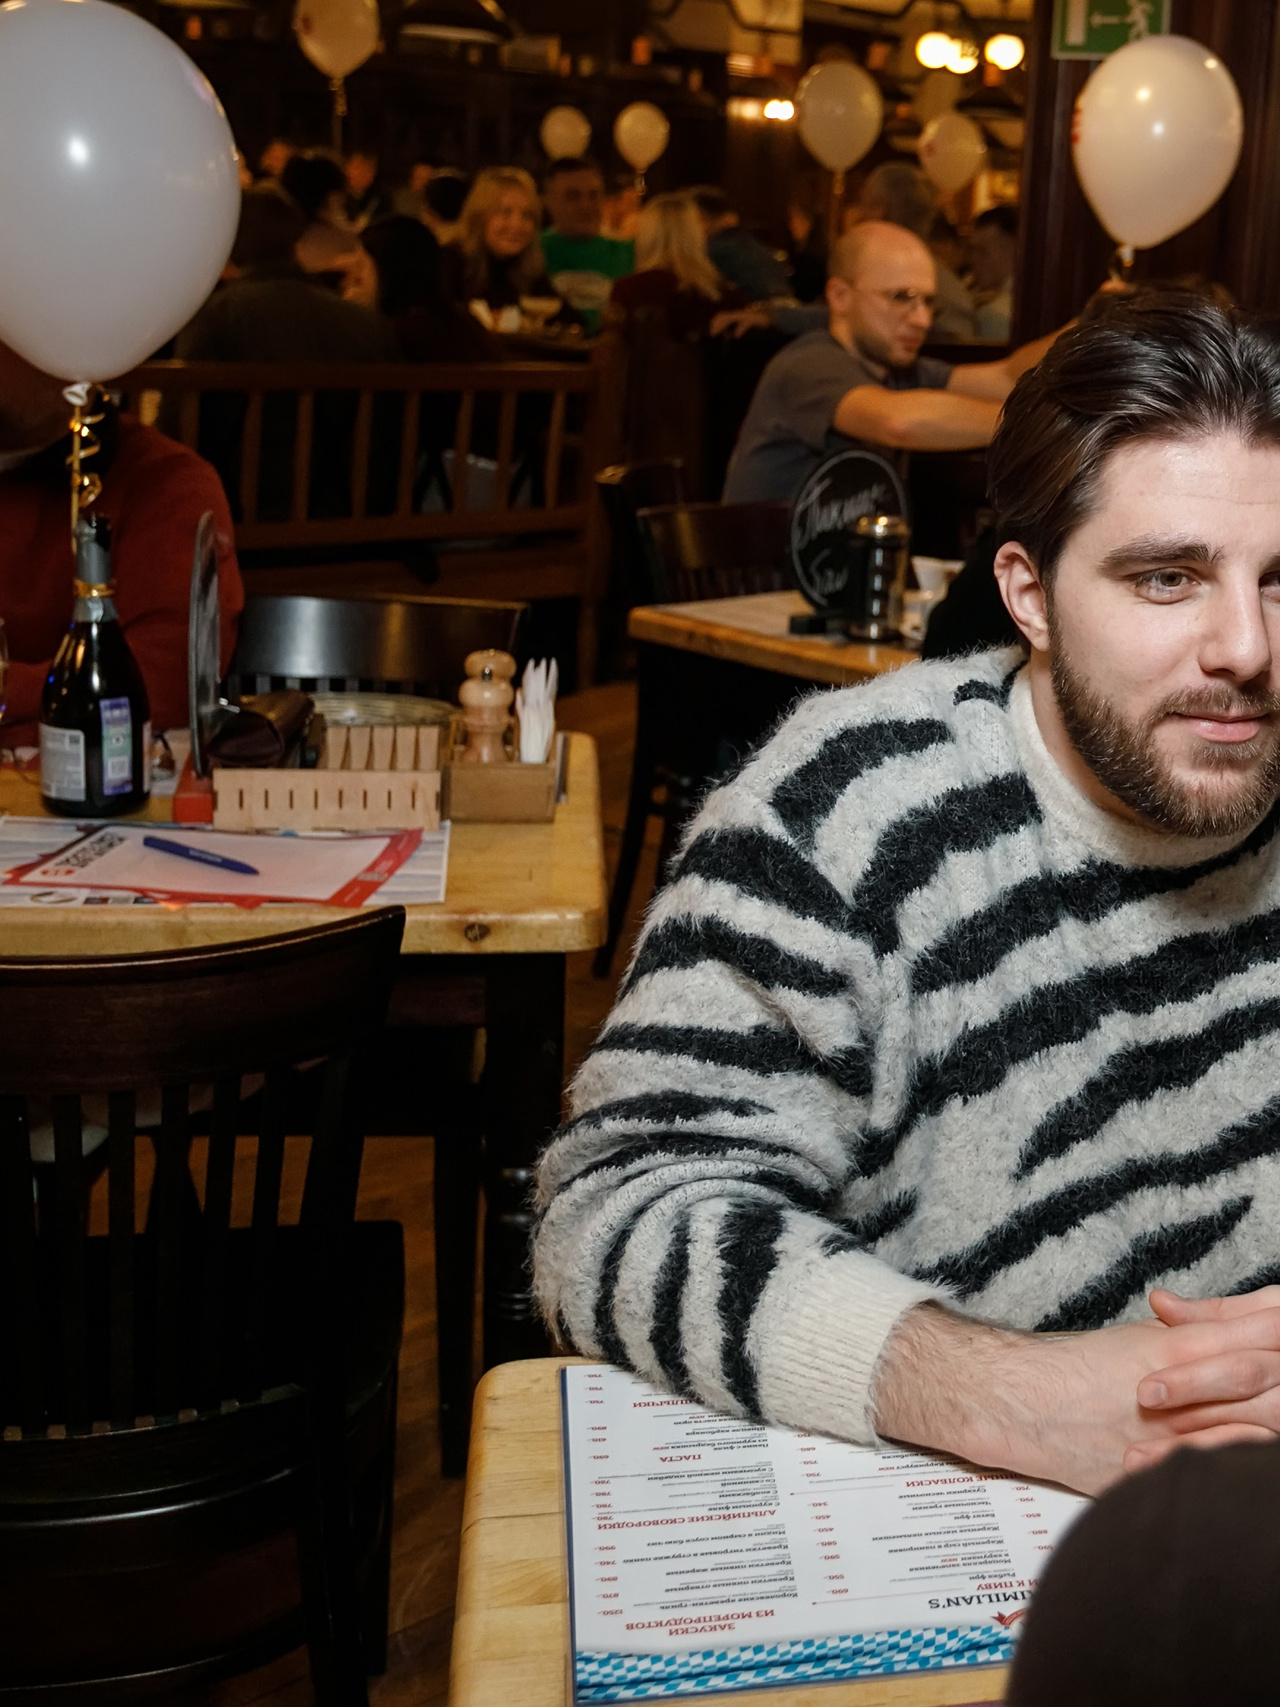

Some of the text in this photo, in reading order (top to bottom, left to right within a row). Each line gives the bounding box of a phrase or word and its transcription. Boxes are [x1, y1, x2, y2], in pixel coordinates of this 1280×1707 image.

[633, 1398, 692, 1408] ШЛЫЧКИ
[670, 1442, 716, 1450] бедрышка
[717, 1438, 756, 1446] куриного
[659, 1454, 701, 1462] ПАСТА
[882, 1452, 919, 1460] колбаска
[896, 1462, 944, 1470] Карривурст
[722, 1467, 766, 1475] кусочками
[906, 1476, 973, 1488] КОЛБАСКИ
[718, 1490, 770, 1498] колбасками
[898, 1492, 945, 1500] чесночные
[708, 1504, 730, 1512] филе
[732, 1501, 772, 1510] куриным
[944, 1500, 991, 1508] Чесночные
[598, 1509, 776, 1530] АЛЬПИЙСКИЕ СКОВОРОДКИ
[959, 1526, 999, 1534] Жареные
[710, 1534, 746, 1542] сырном
[872, 1532, 923, 1542] пельмешки
[962, 1538, 1004, 1548] Жареный
[700, 1548, 744, 1556] тигровые
[746, 1544, 788, 1552] Креветки
[888, 1546, 936, 1554] панировке
[653, 1553, 692, 1561] стружке
[962, 1558, 1011, 1568] Моцарелла
[666, 1560, 792, 1576] Креветки пивные жареные
[712, 1580, 749, 1588] пивные
[751, 1576, 795, 1585] Креветки
[664, 1584, 710, 1592] отварные
[976, 1580, 1013, 1590] ПИВУ
[738, 1592, 798, 1602] Королевские
[626, 1609, 775, 1630] ИЗ МОРЕПРОДУКТОВ
[668, 1622, 735, 1636] ЗАКУСКИ
